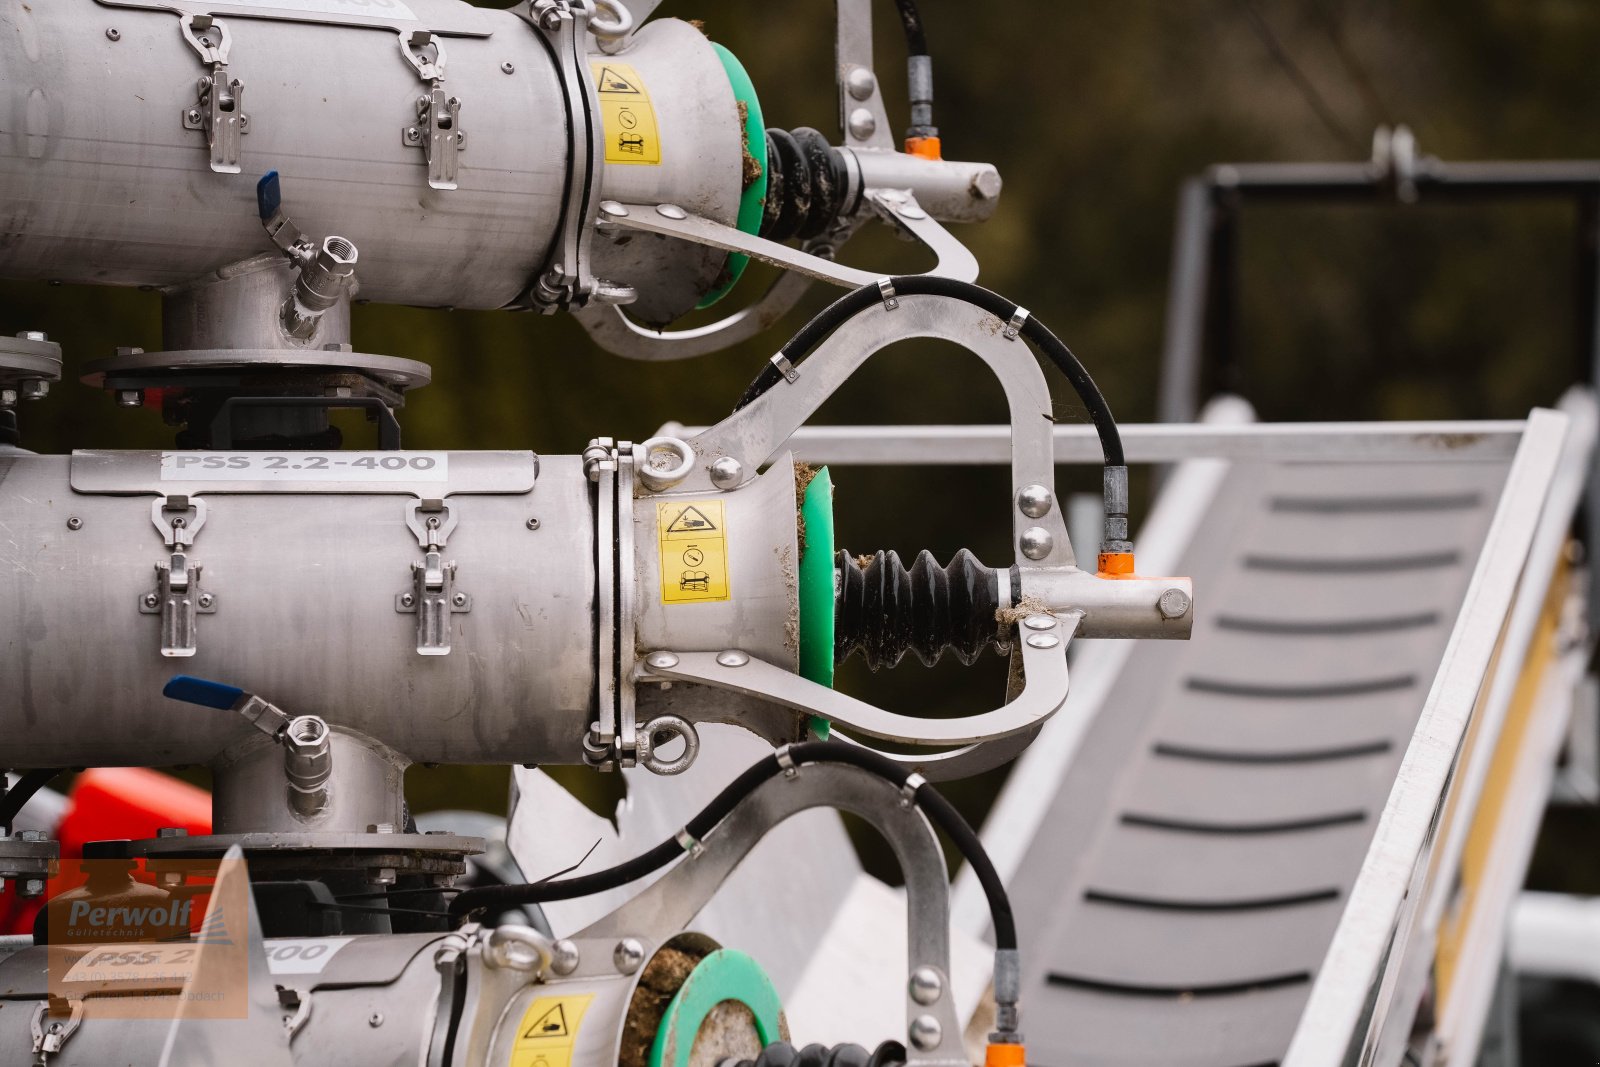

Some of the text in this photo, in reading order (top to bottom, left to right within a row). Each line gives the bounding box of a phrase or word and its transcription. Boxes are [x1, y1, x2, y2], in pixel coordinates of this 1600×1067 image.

[176, 456, 436, 470] PSS 2.2-400
[87, 952, 164, 967] PSS
